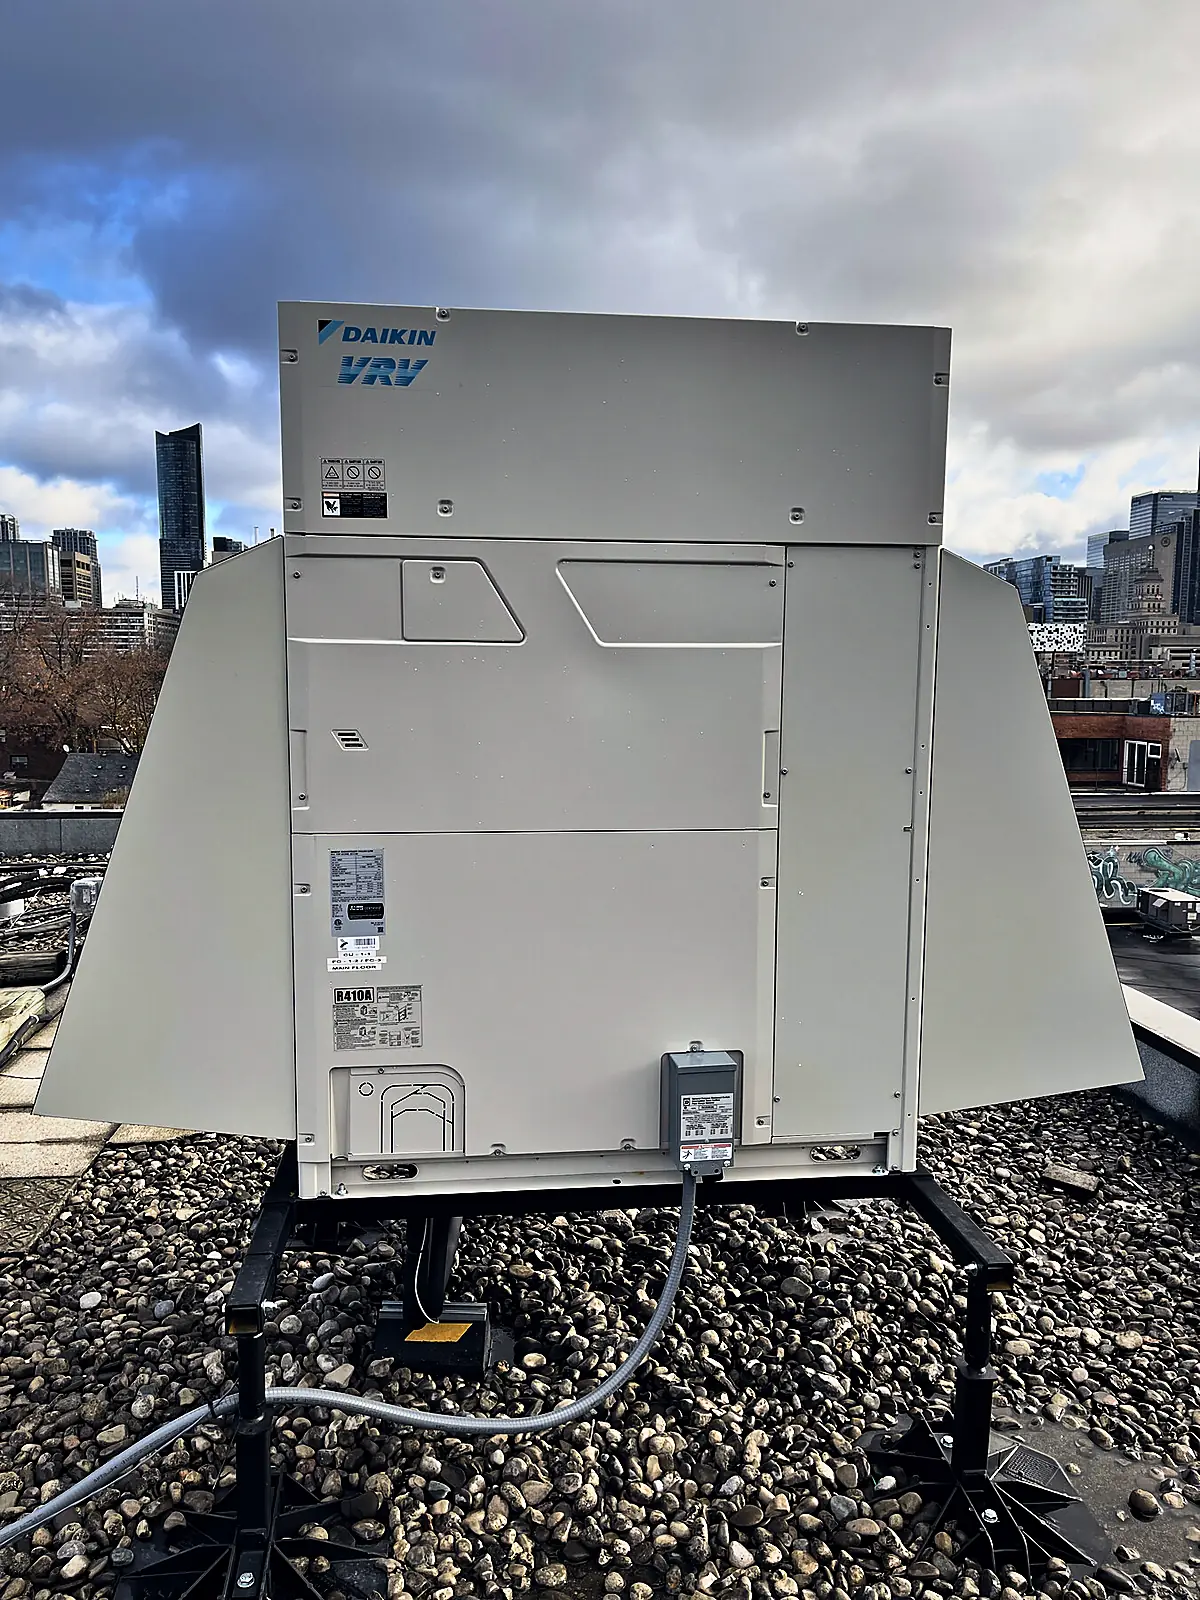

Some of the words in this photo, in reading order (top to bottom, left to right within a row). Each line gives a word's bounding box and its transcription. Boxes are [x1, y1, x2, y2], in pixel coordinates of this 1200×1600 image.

[342, 326, 436, 346] DAIKIN
[337, 355, 429, 387] VRV
[336, 989, 372, 1002] R410A
